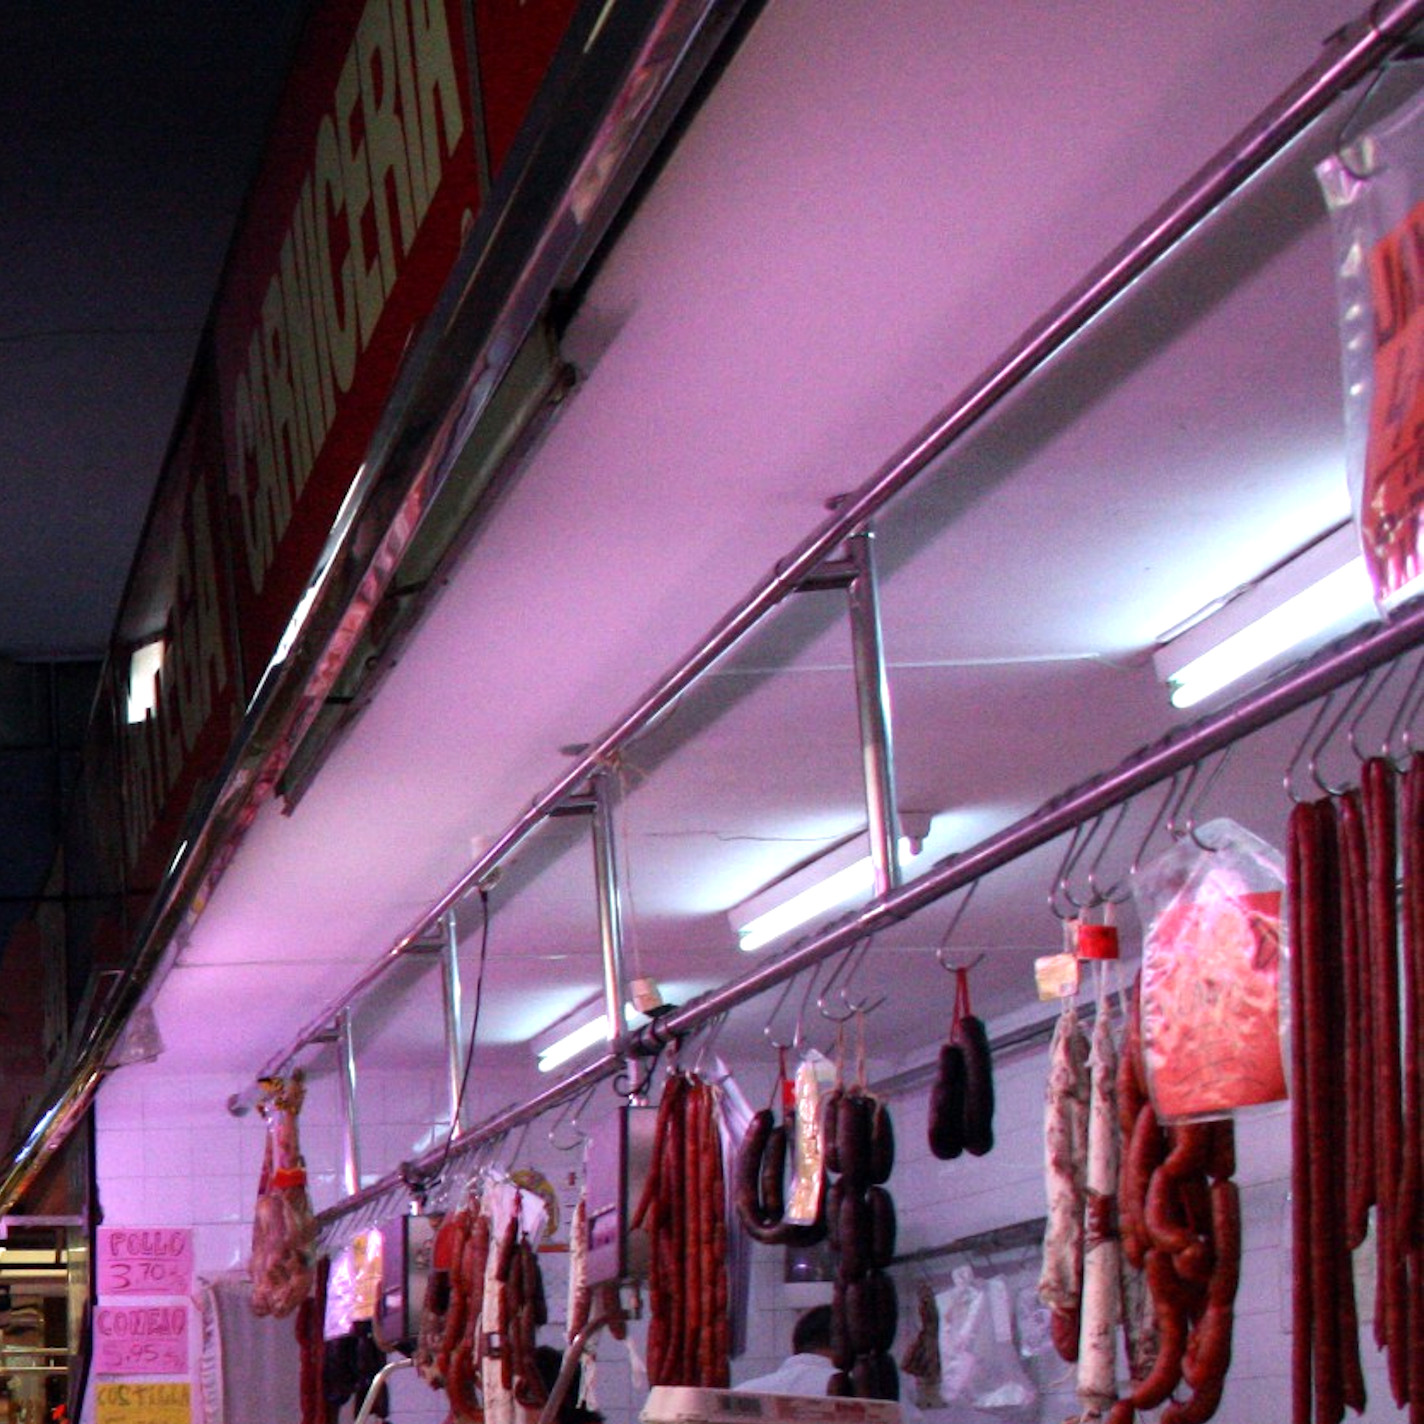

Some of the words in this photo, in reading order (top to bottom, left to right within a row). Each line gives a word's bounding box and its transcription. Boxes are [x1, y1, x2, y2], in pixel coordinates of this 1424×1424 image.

[235, 0, 465, 594] CARNICERIA
[109, 1231, 186, 1257] POLLO
[96, 1309, 186, 1336] CONEJO
